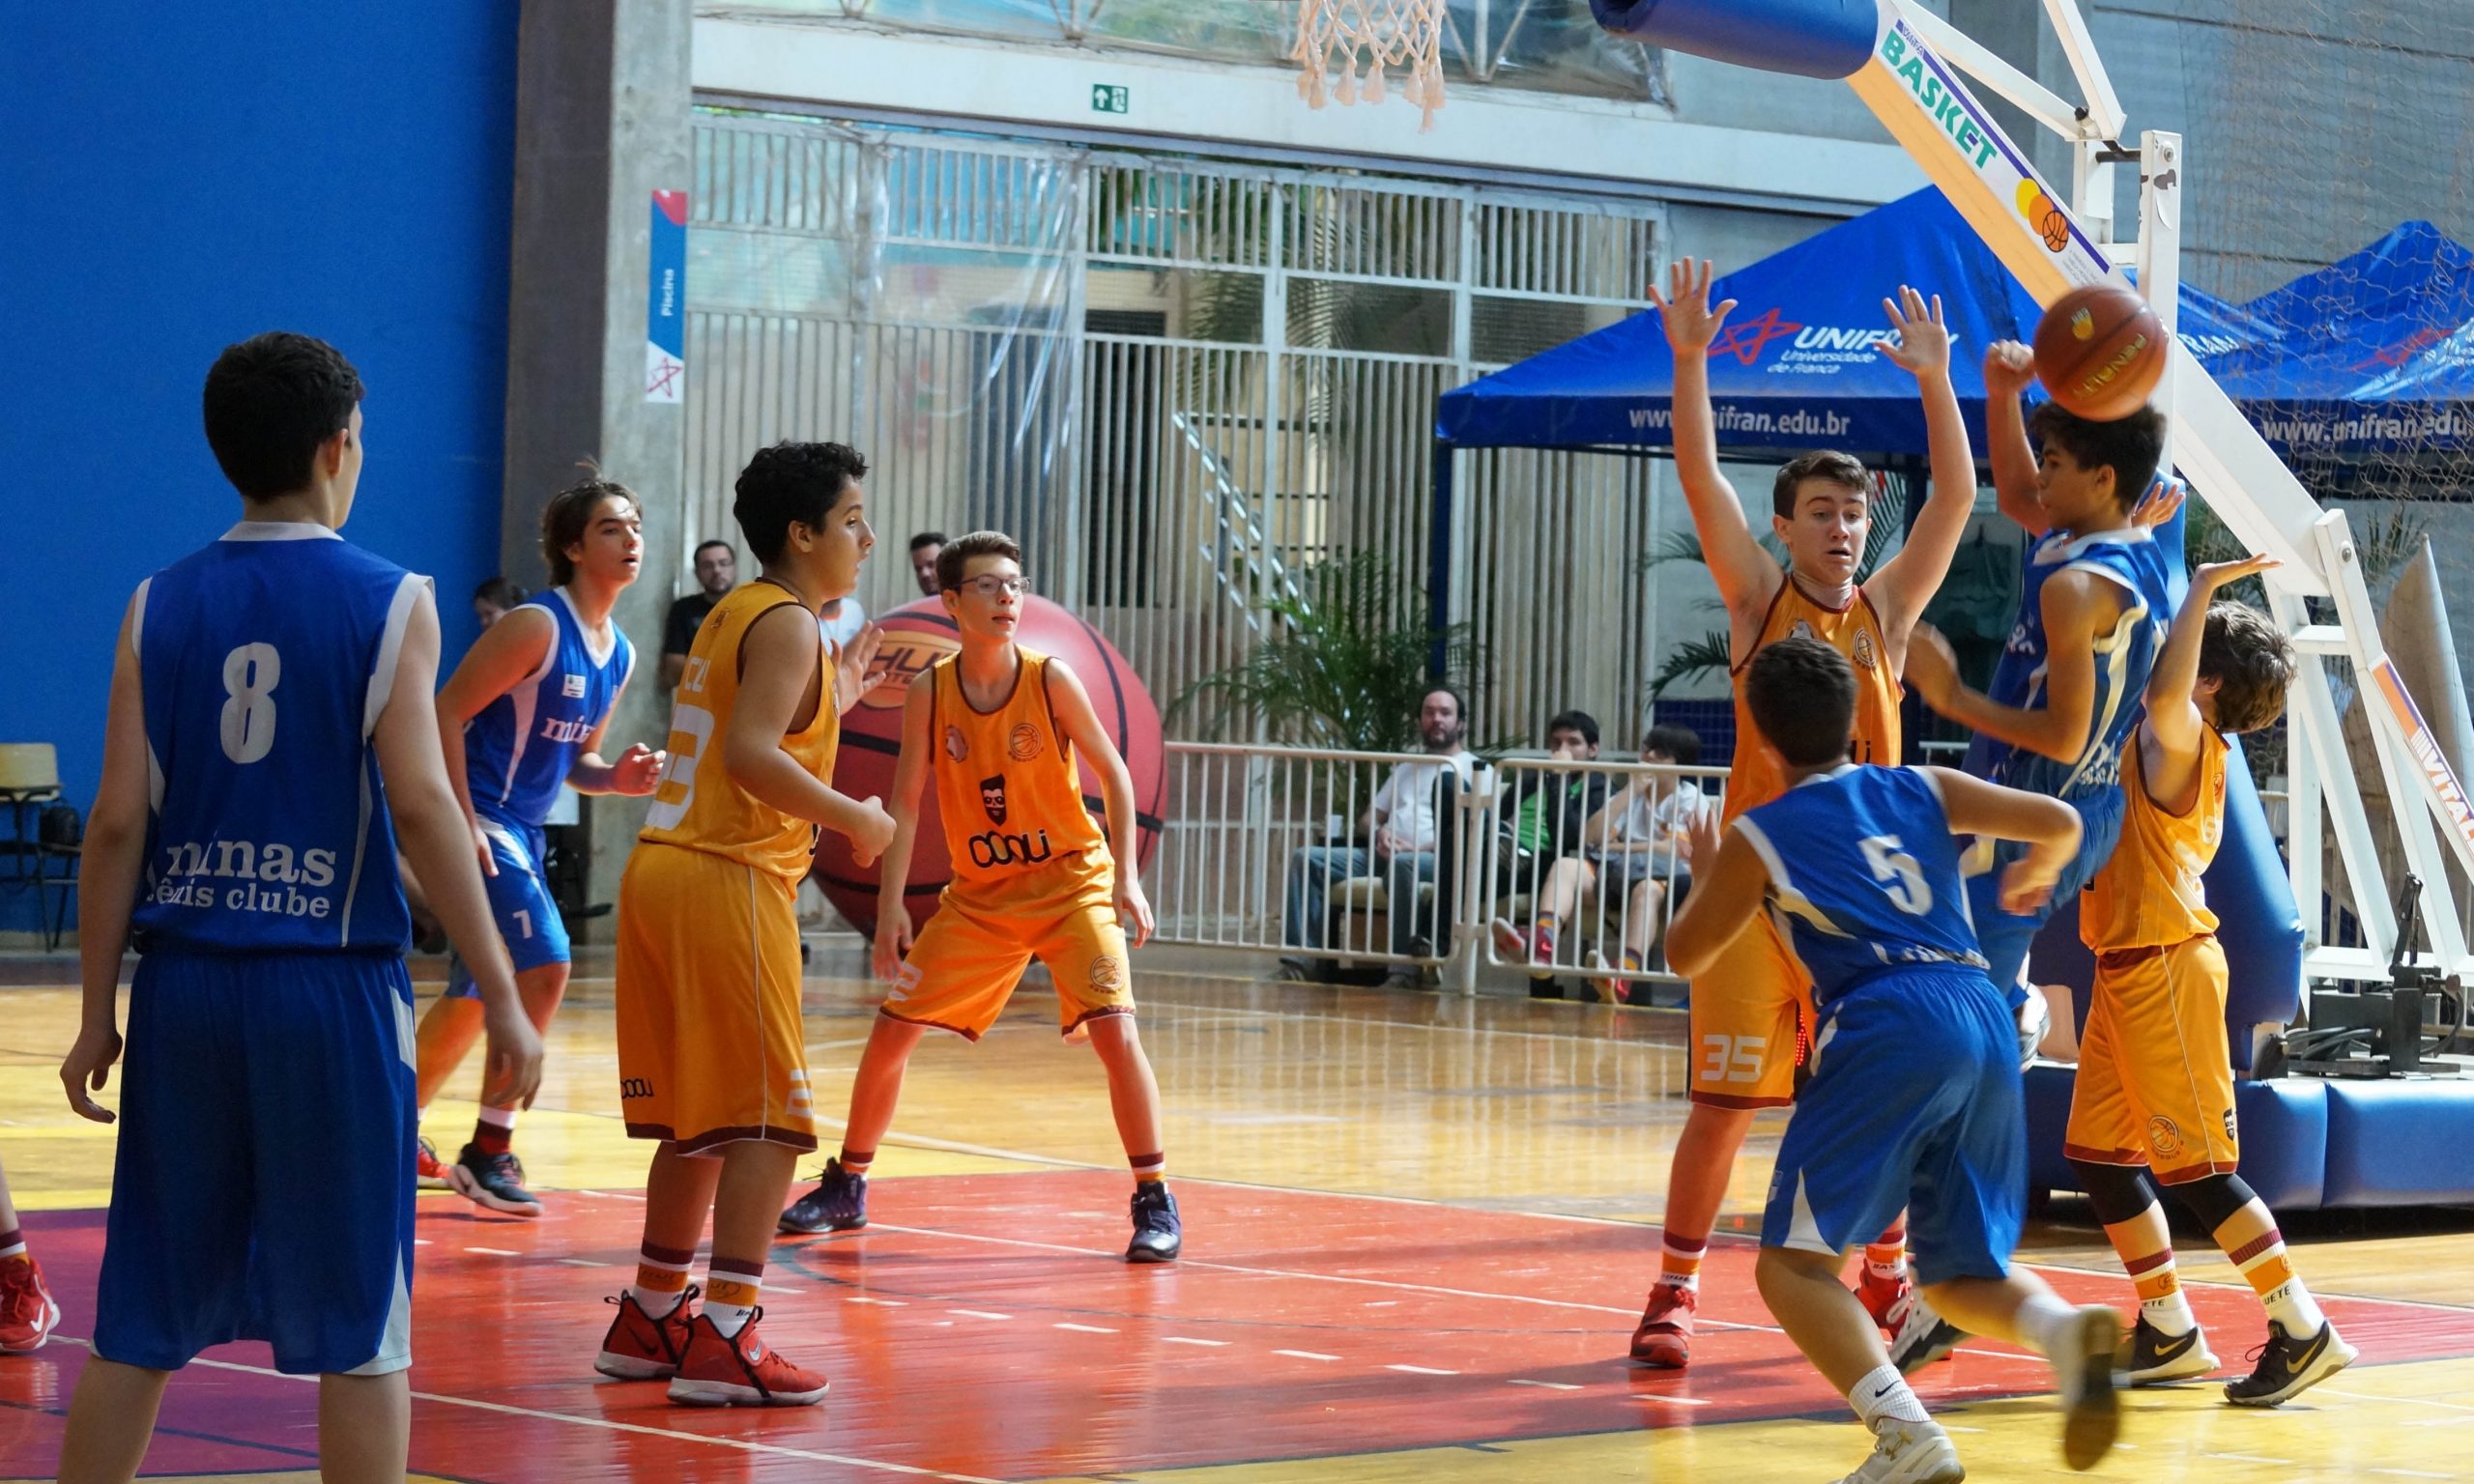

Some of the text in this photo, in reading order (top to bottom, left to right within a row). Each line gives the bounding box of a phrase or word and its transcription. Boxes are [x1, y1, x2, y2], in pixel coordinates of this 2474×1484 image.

[1880, 29, 1998, 169] BASKET
[661, 269, 675, 317] Piscina
[1780, 350, 1877, 363] Universidade
[220, 642, 280, 763] 8
[1857, 834, 1933, 916] 5
[226, 883, 331, 918] clube
[1701, 1035, 1767, 1082] 35
